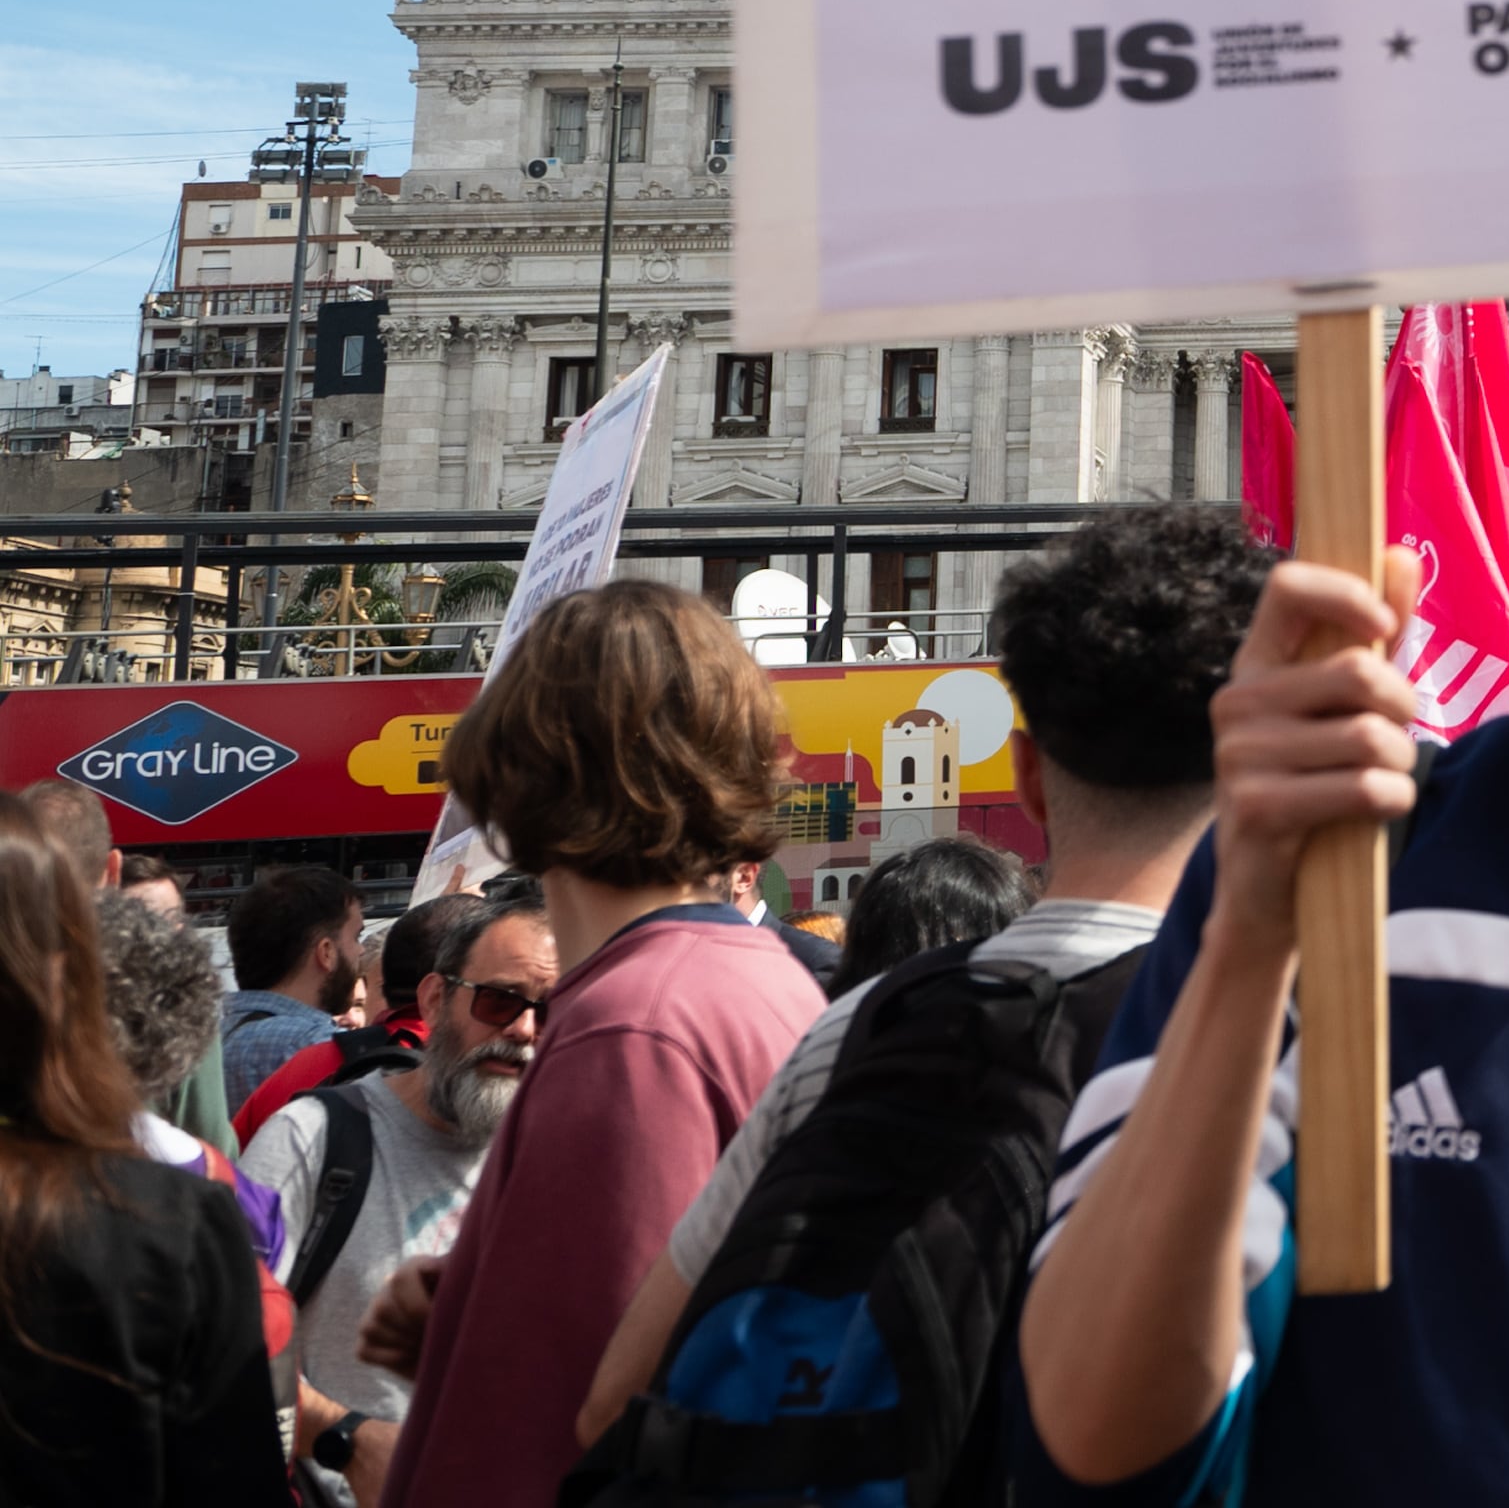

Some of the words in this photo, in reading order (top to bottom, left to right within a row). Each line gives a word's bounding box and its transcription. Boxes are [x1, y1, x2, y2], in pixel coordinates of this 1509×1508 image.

[939, 20, 1201, 118] UJS
[409, 722, 457, 742] Tur
[81, 747, 187, 781] Gray
[193, 740, 276, 775] Line
[1387, 1123, 1482, 1162] didas
